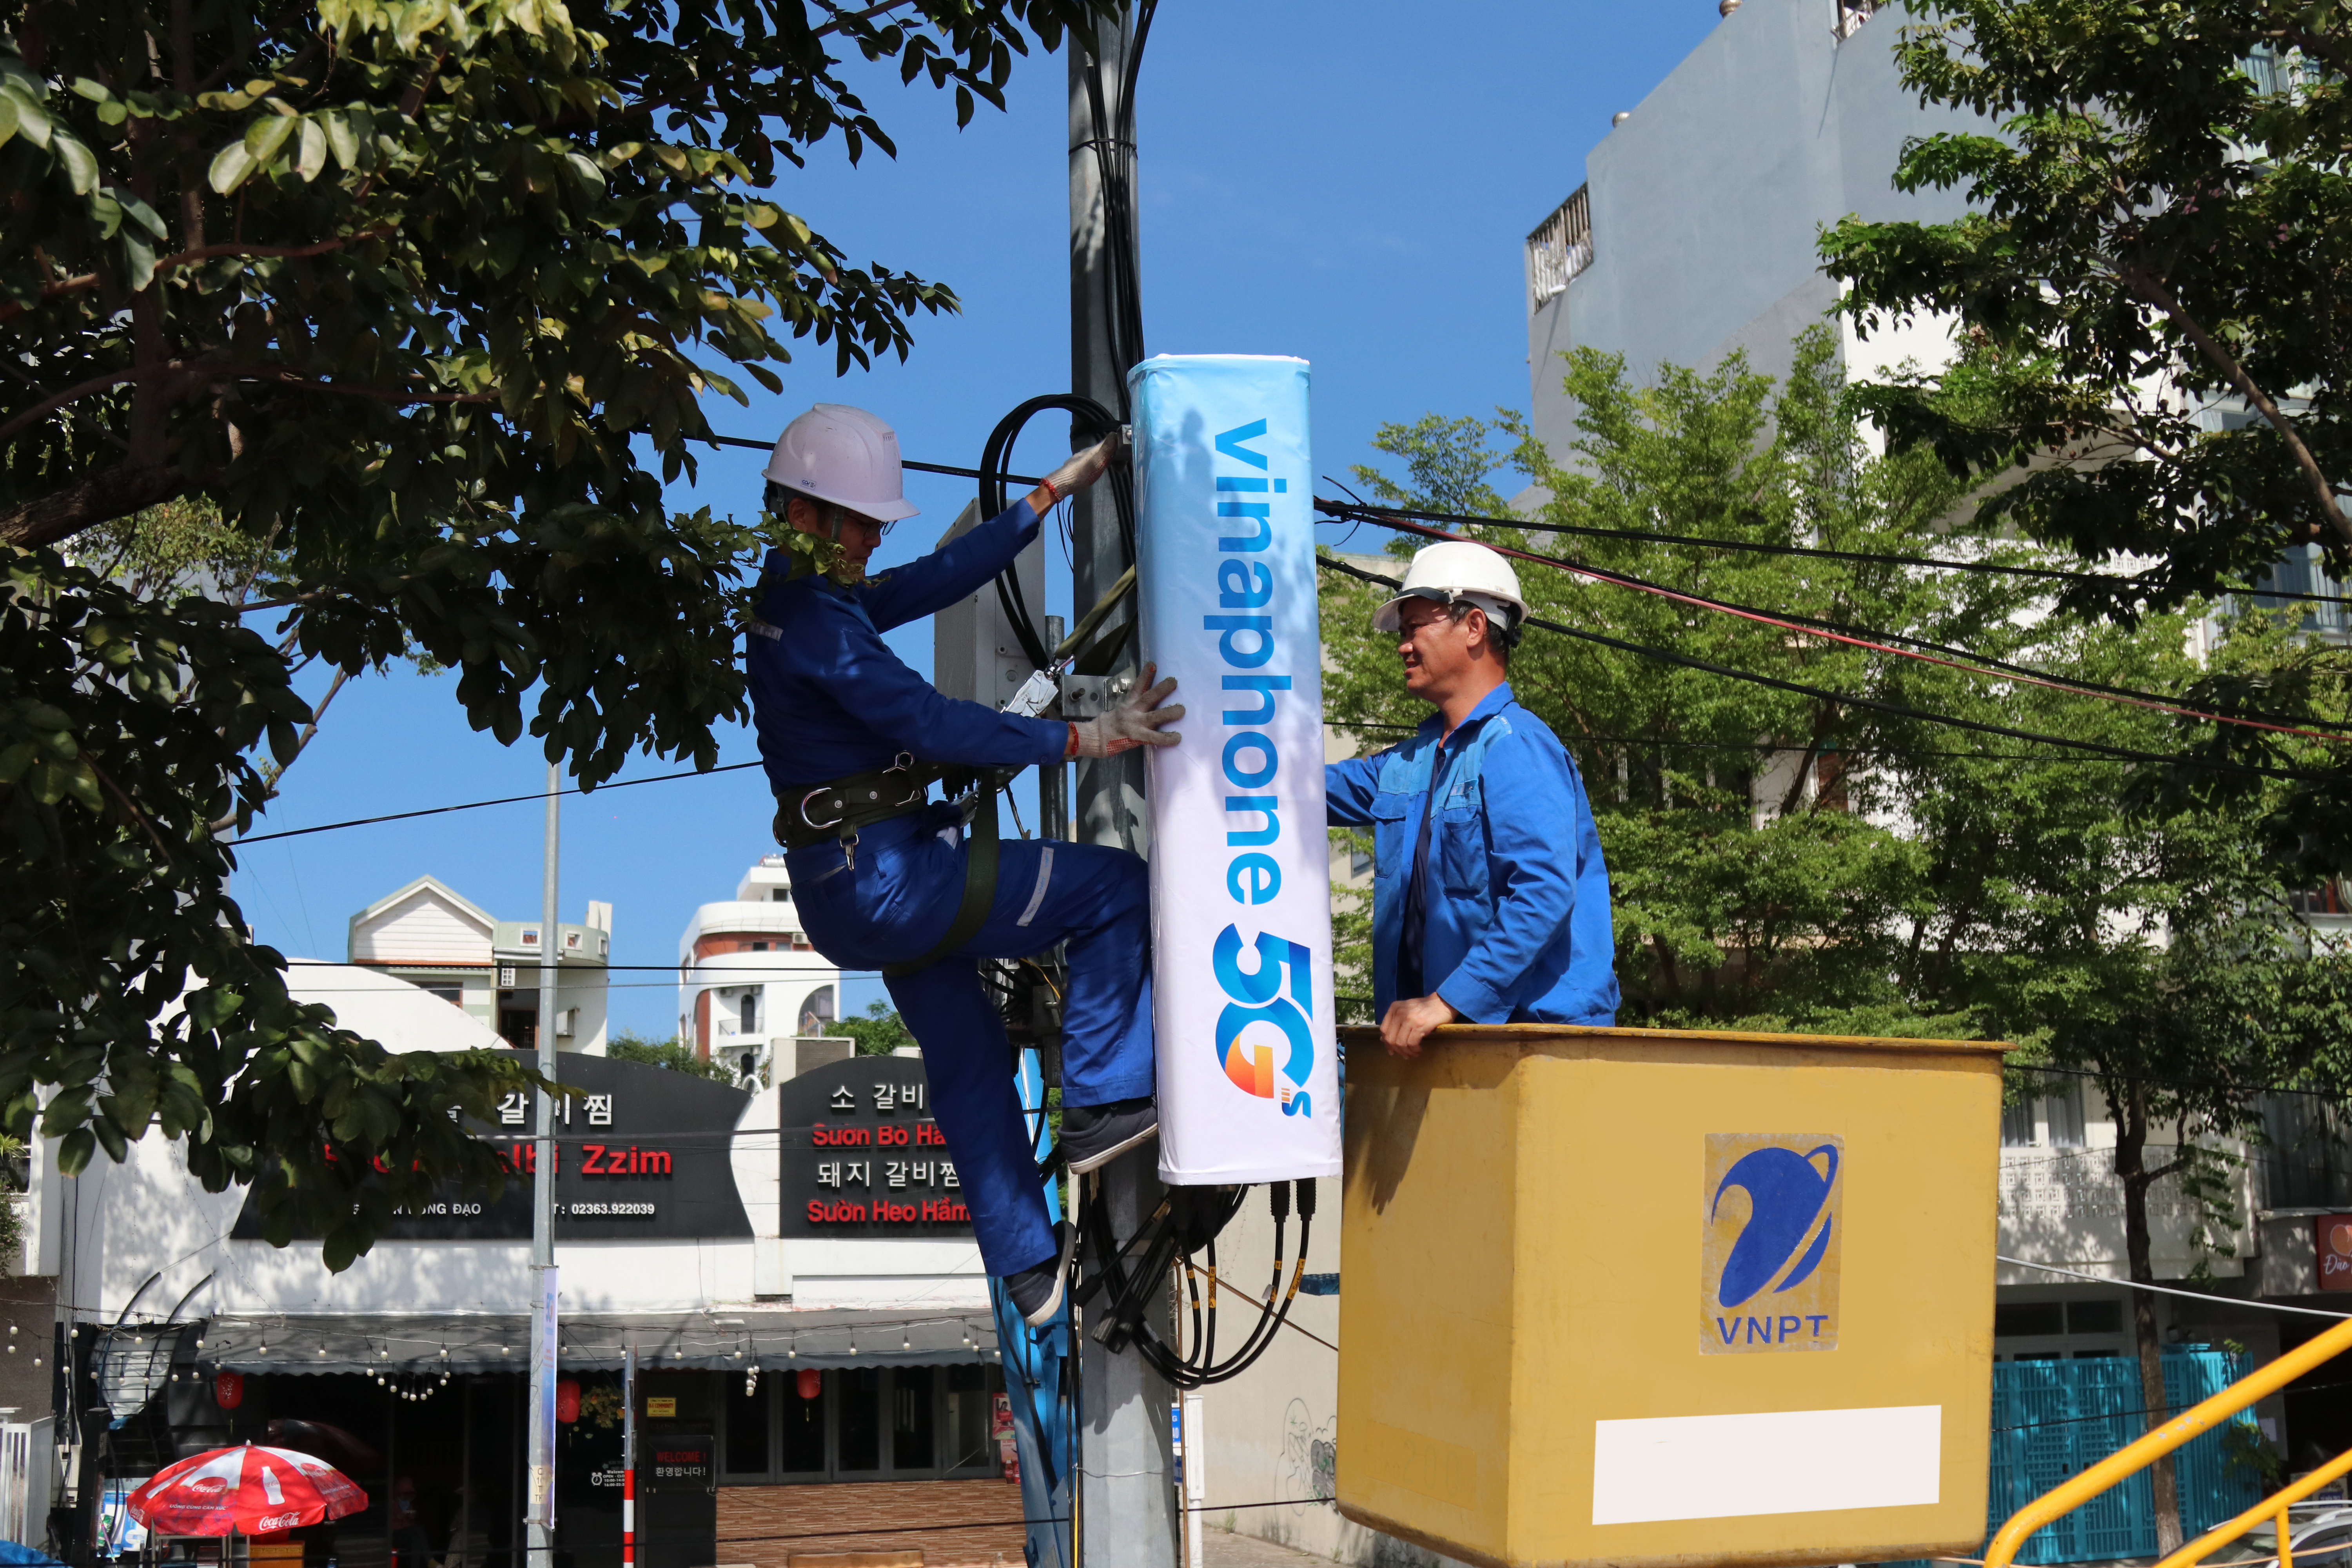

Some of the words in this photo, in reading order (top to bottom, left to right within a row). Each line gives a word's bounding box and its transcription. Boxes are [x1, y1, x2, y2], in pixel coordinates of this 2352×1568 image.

[1203, 417, 1292, 906] vinaphone
[830, 1085, 855, 1108] 소
[878, 1124, 909, 1145] Bò
[581, 1144, 672, 1174] Zzim
[818, 1161, 870, 1188] 돼지
[452, 1203, 481, 1216] ĐẠO
[571, 1203, 655, 1215] 02363.922039
[807, 1199, 866, 1222] Sườn
[872, 1200, 918, 1222] Heo
[1717, 1315, 1829, 1345] VNPT
[656, 1451, 701, 1462] WELCOME
[259, 1511, 301, 1531] Coca-Cola
